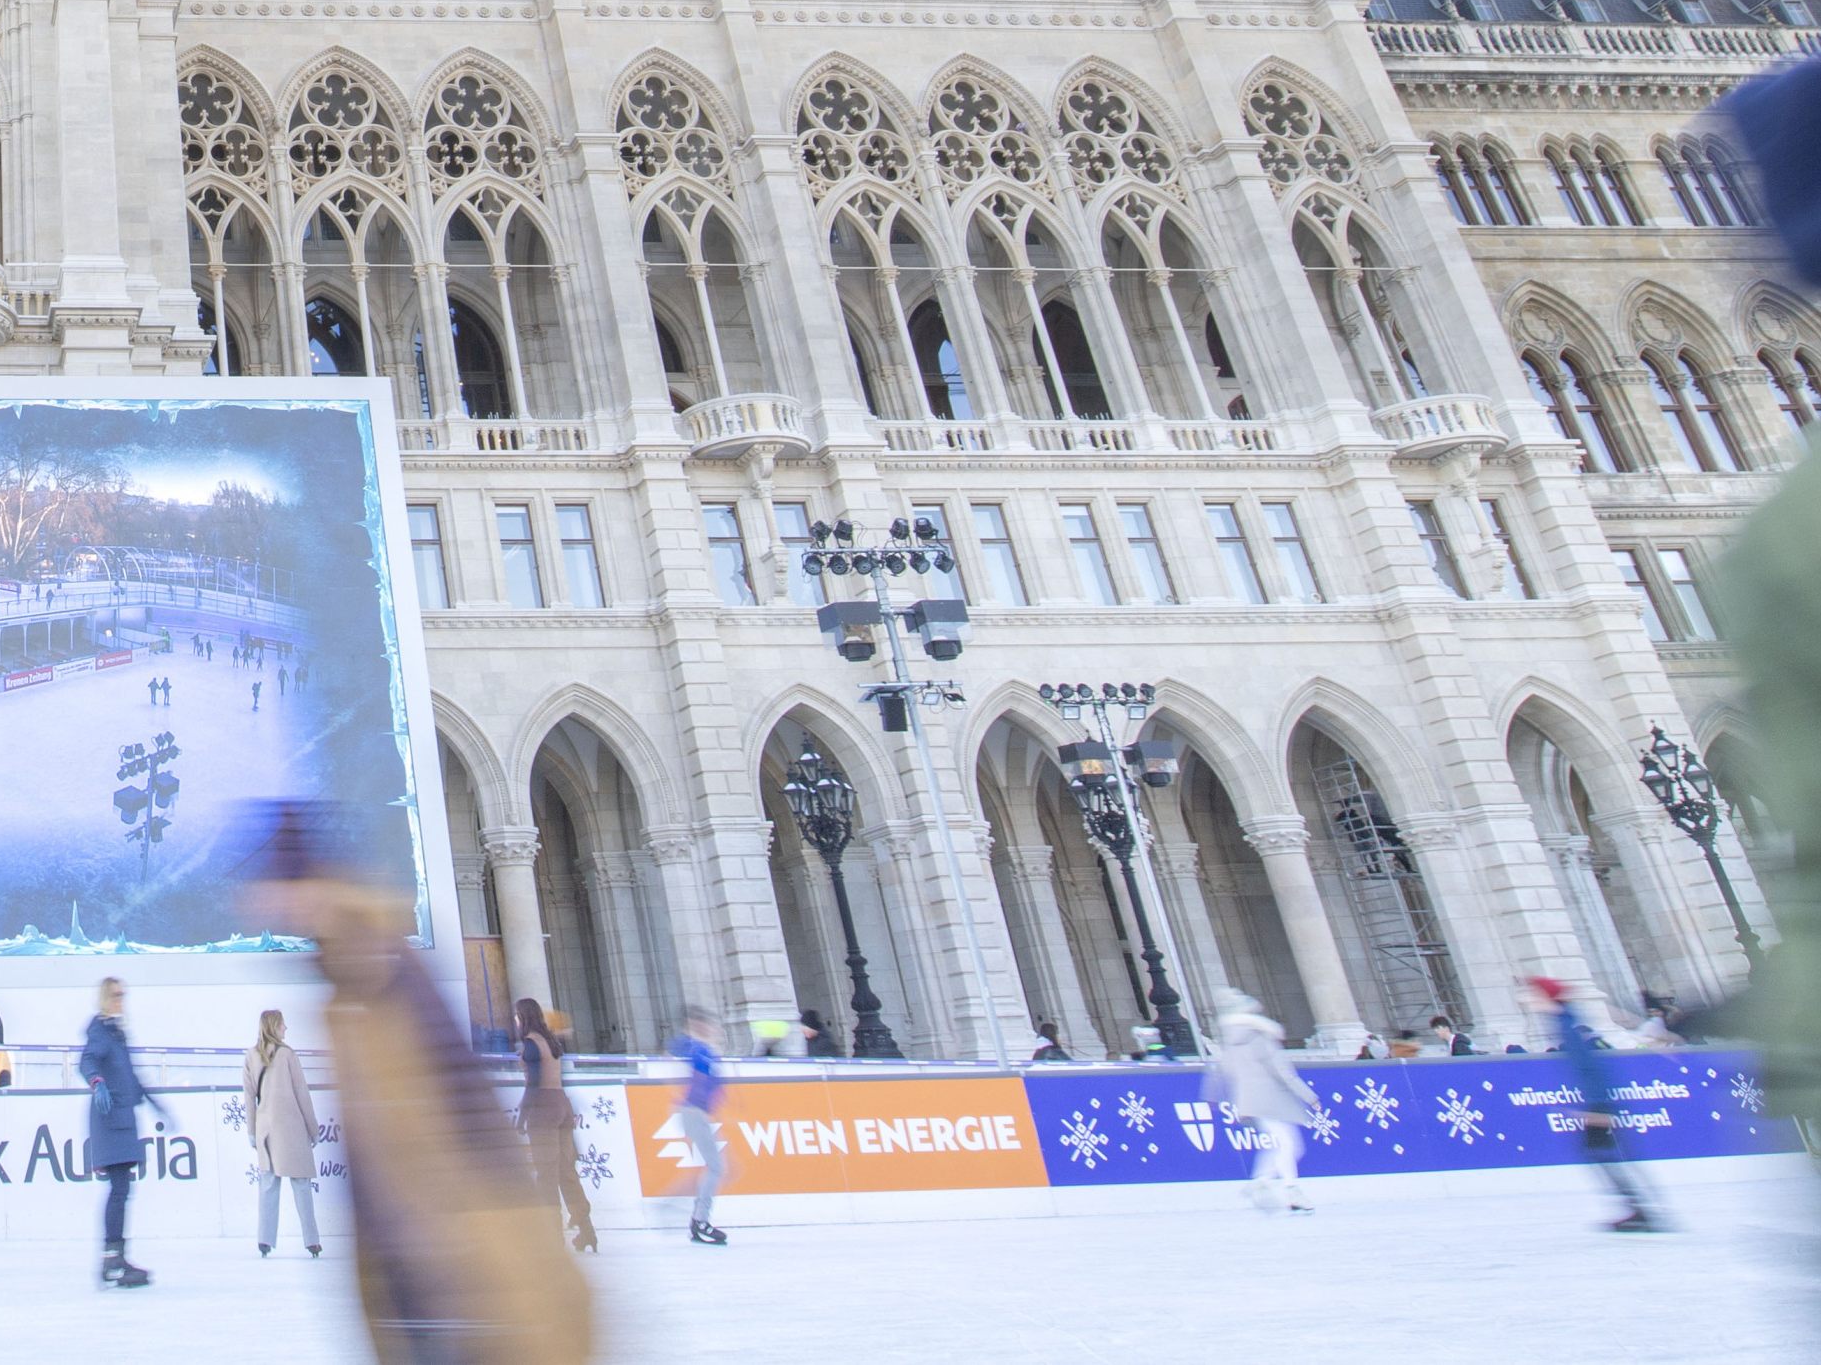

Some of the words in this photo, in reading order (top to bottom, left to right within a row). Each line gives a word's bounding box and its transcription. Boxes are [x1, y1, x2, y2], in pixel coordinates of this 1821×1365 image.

[1508, 1085, 1585, 1106] wünscht
[738, 1119, 849, 1157] WIEN
[853, 1115, 1022, 1154] ENERGIE
